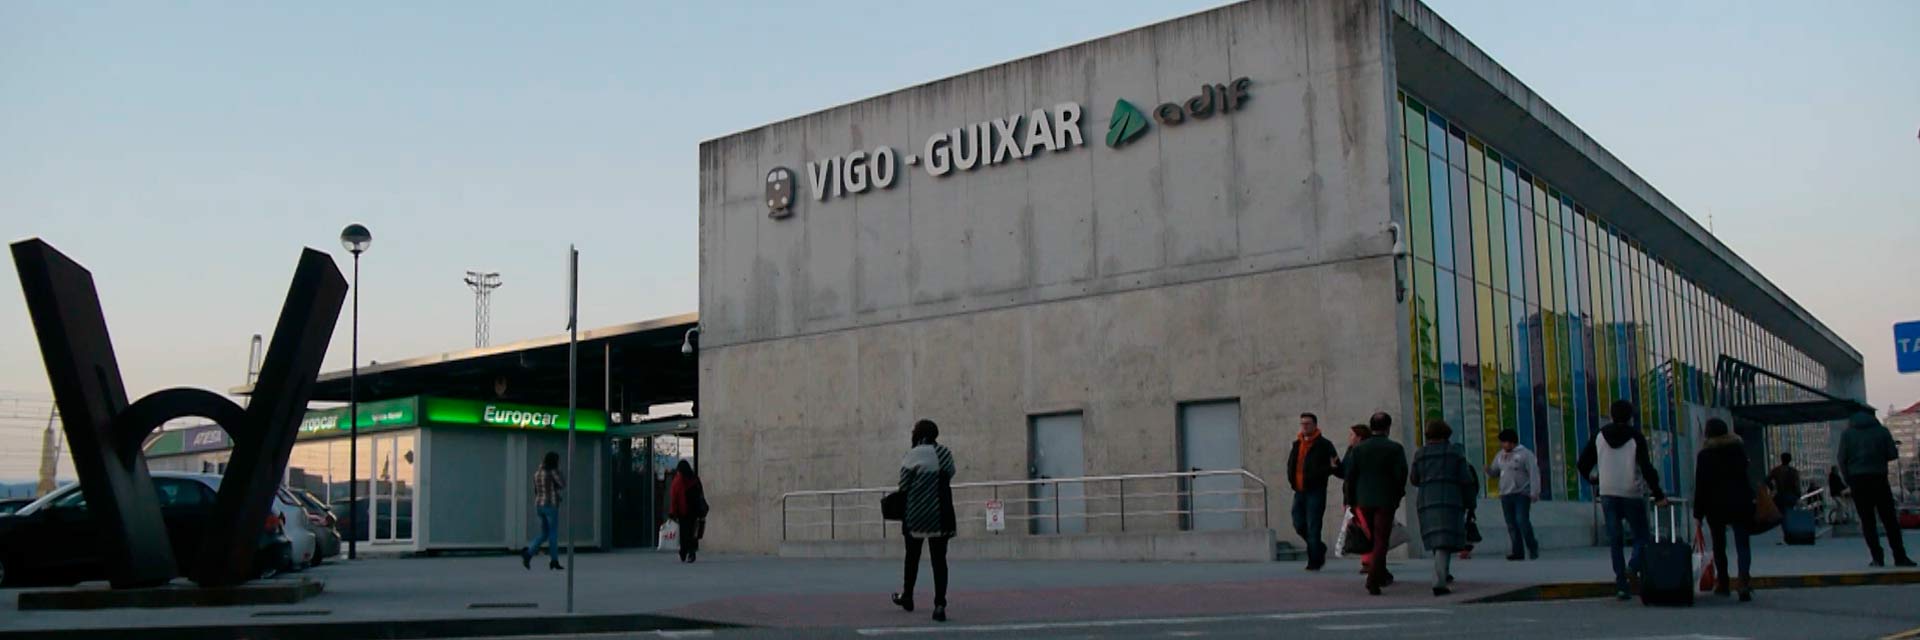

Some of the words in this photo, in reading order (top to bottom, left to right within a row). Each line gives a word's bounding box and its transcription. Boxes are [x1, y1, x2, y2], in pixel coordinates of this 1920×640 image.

[1153, 76, 1252, 126] adif
[807, 146, 894, 201] VIGO
[925, 102, 1083, 176] GUIXAR
[299, 414, 338, 433] uropcar
[484, 405, 559, 429] Europcar
